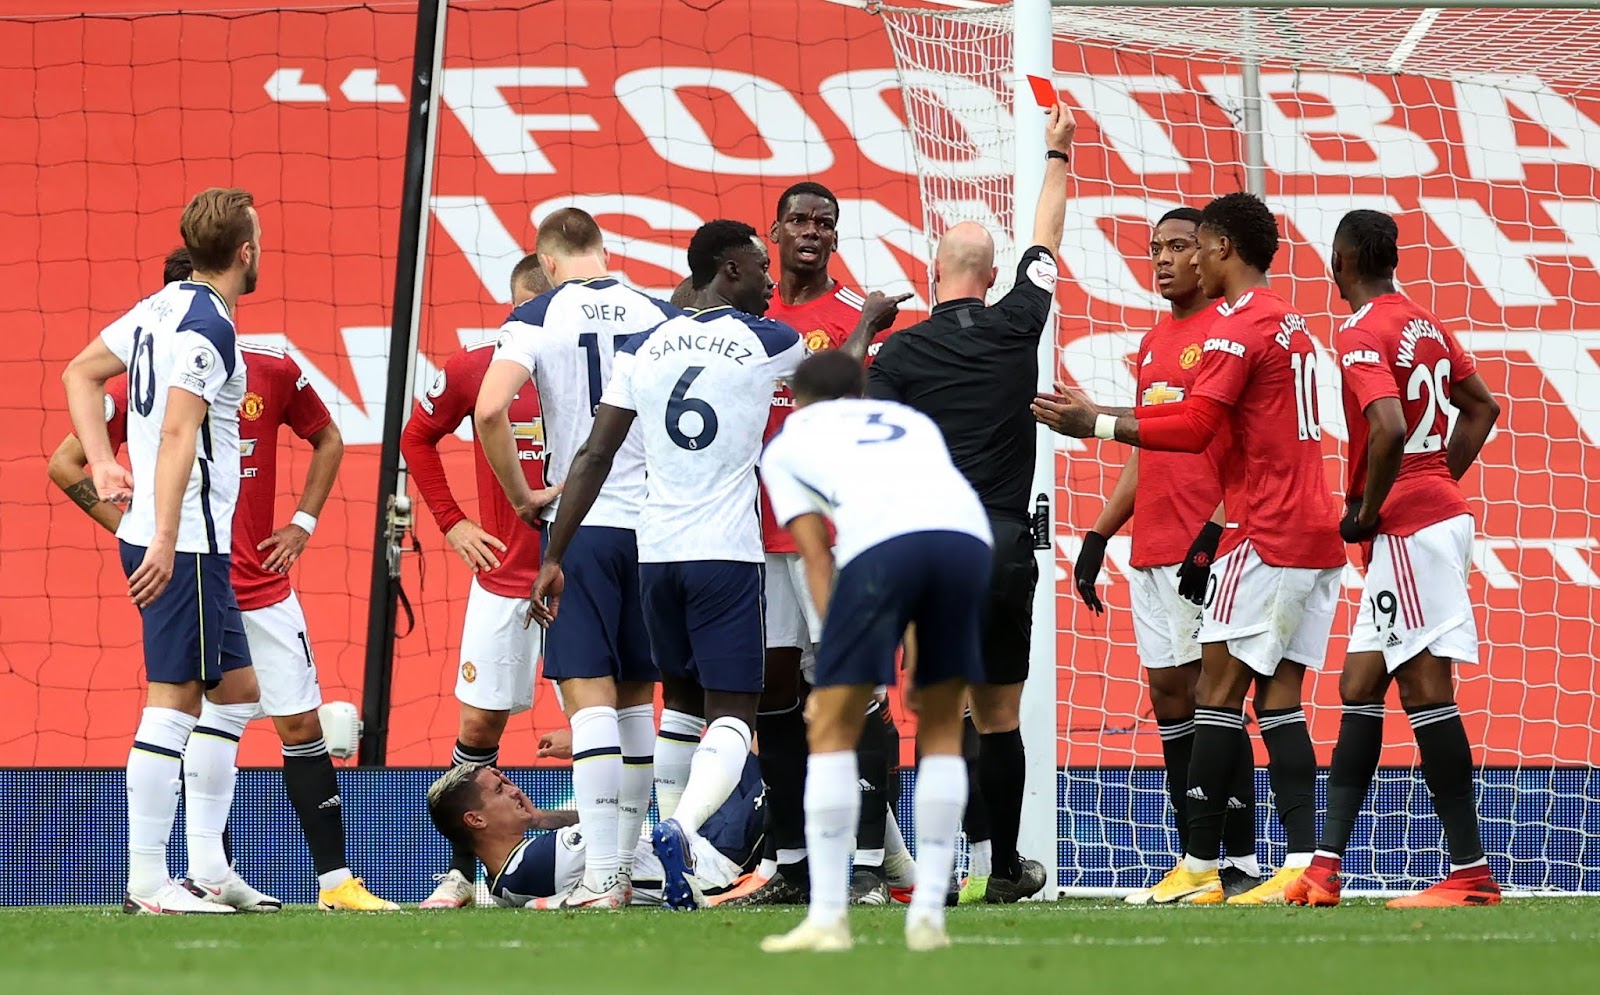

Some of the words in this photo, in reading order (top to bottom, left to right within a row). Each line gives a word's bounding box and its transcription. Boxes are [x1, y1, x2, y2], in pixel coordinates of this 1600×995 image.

[581, 304, 627, 322] DIER
[127, 326, 155, 418] 10
[665, 366, 718, 451] 6
[1291, 352, 1321, 441] 10
[1403, 358, 1460, 454] 29
[857, 413, 906, 445] 3
